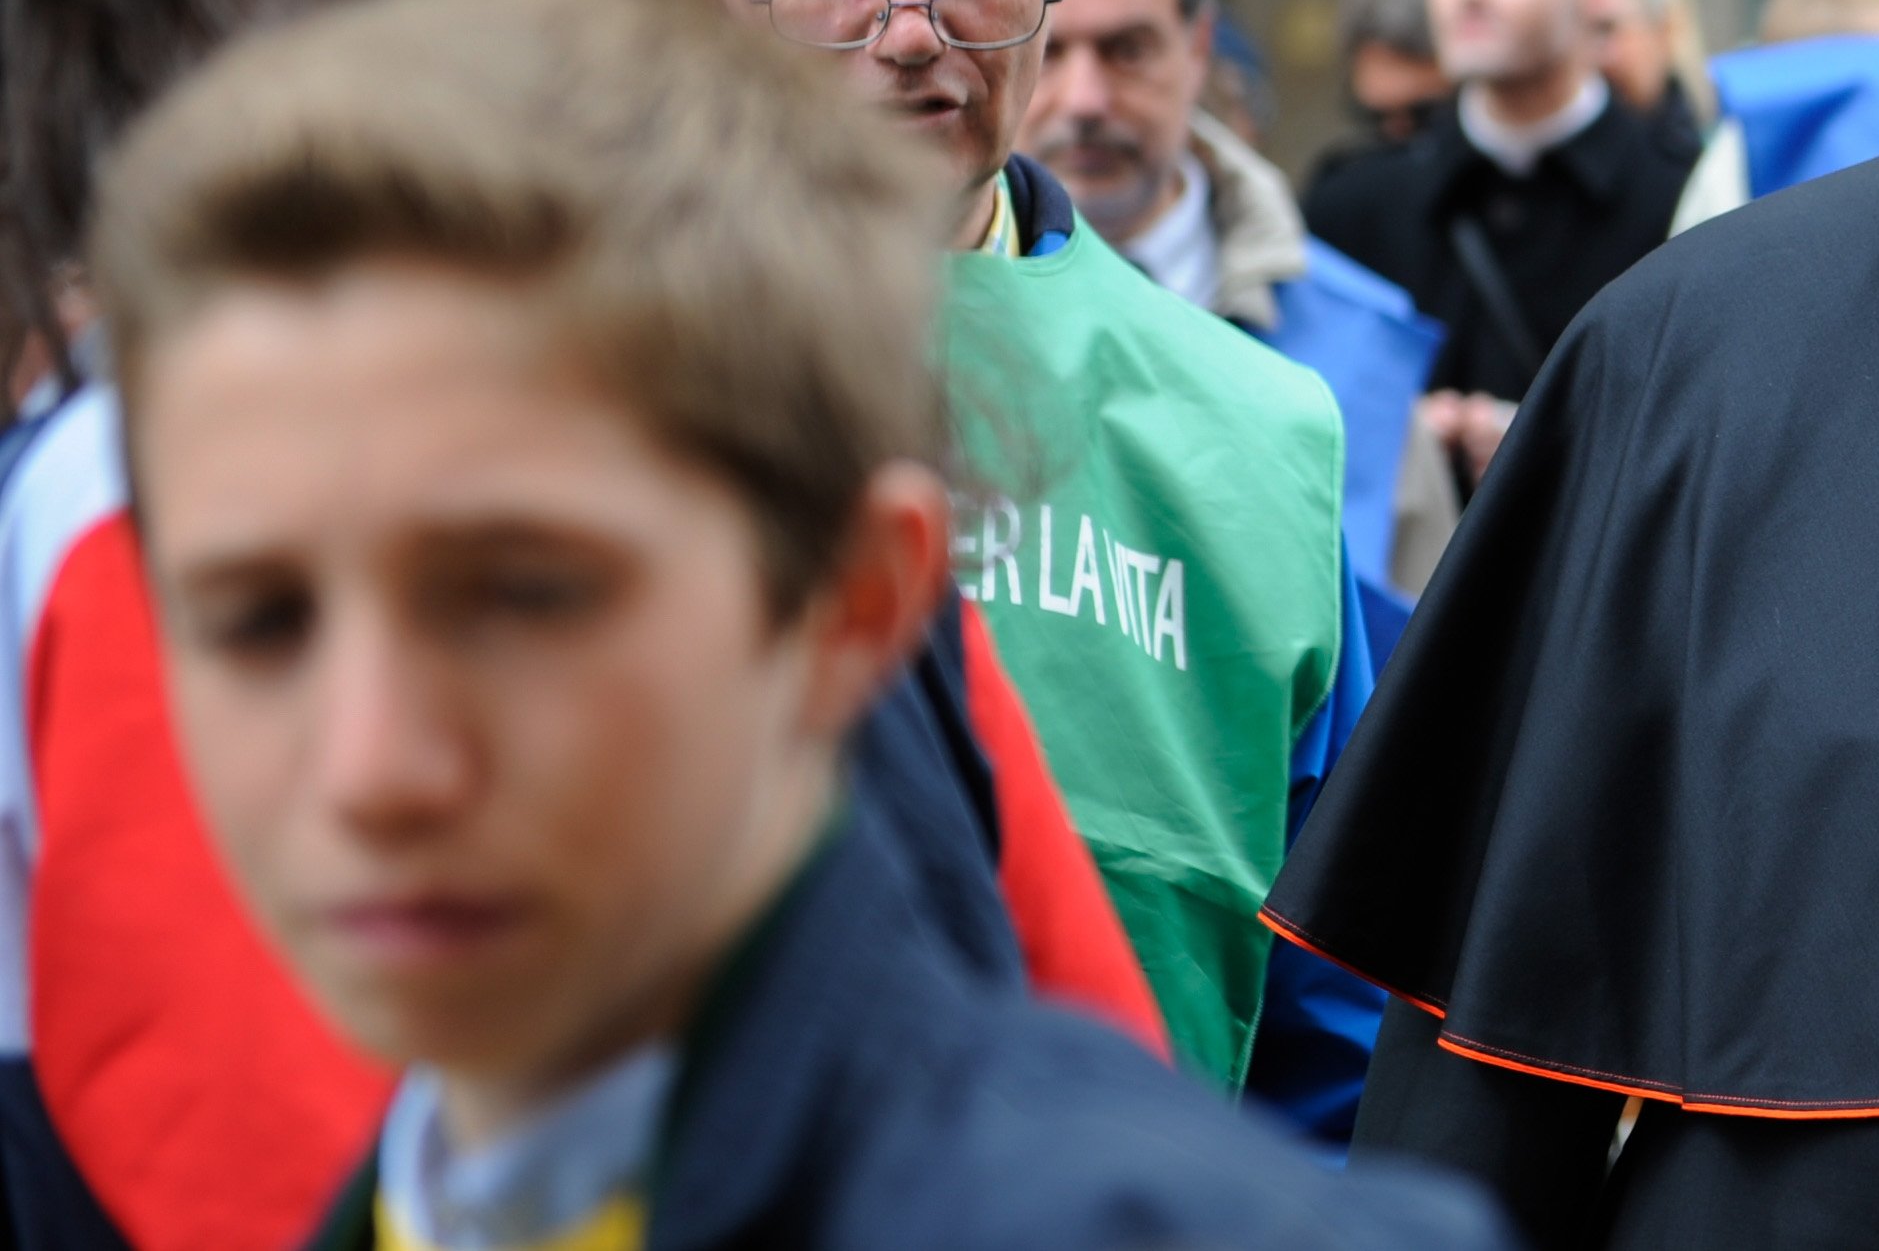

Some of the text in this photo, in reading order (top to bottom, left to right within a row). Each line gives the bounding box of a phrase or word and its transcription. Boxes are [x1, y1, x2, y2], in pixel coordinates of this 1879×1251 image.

[948, 496, 1187, 671] ER LA VITA
